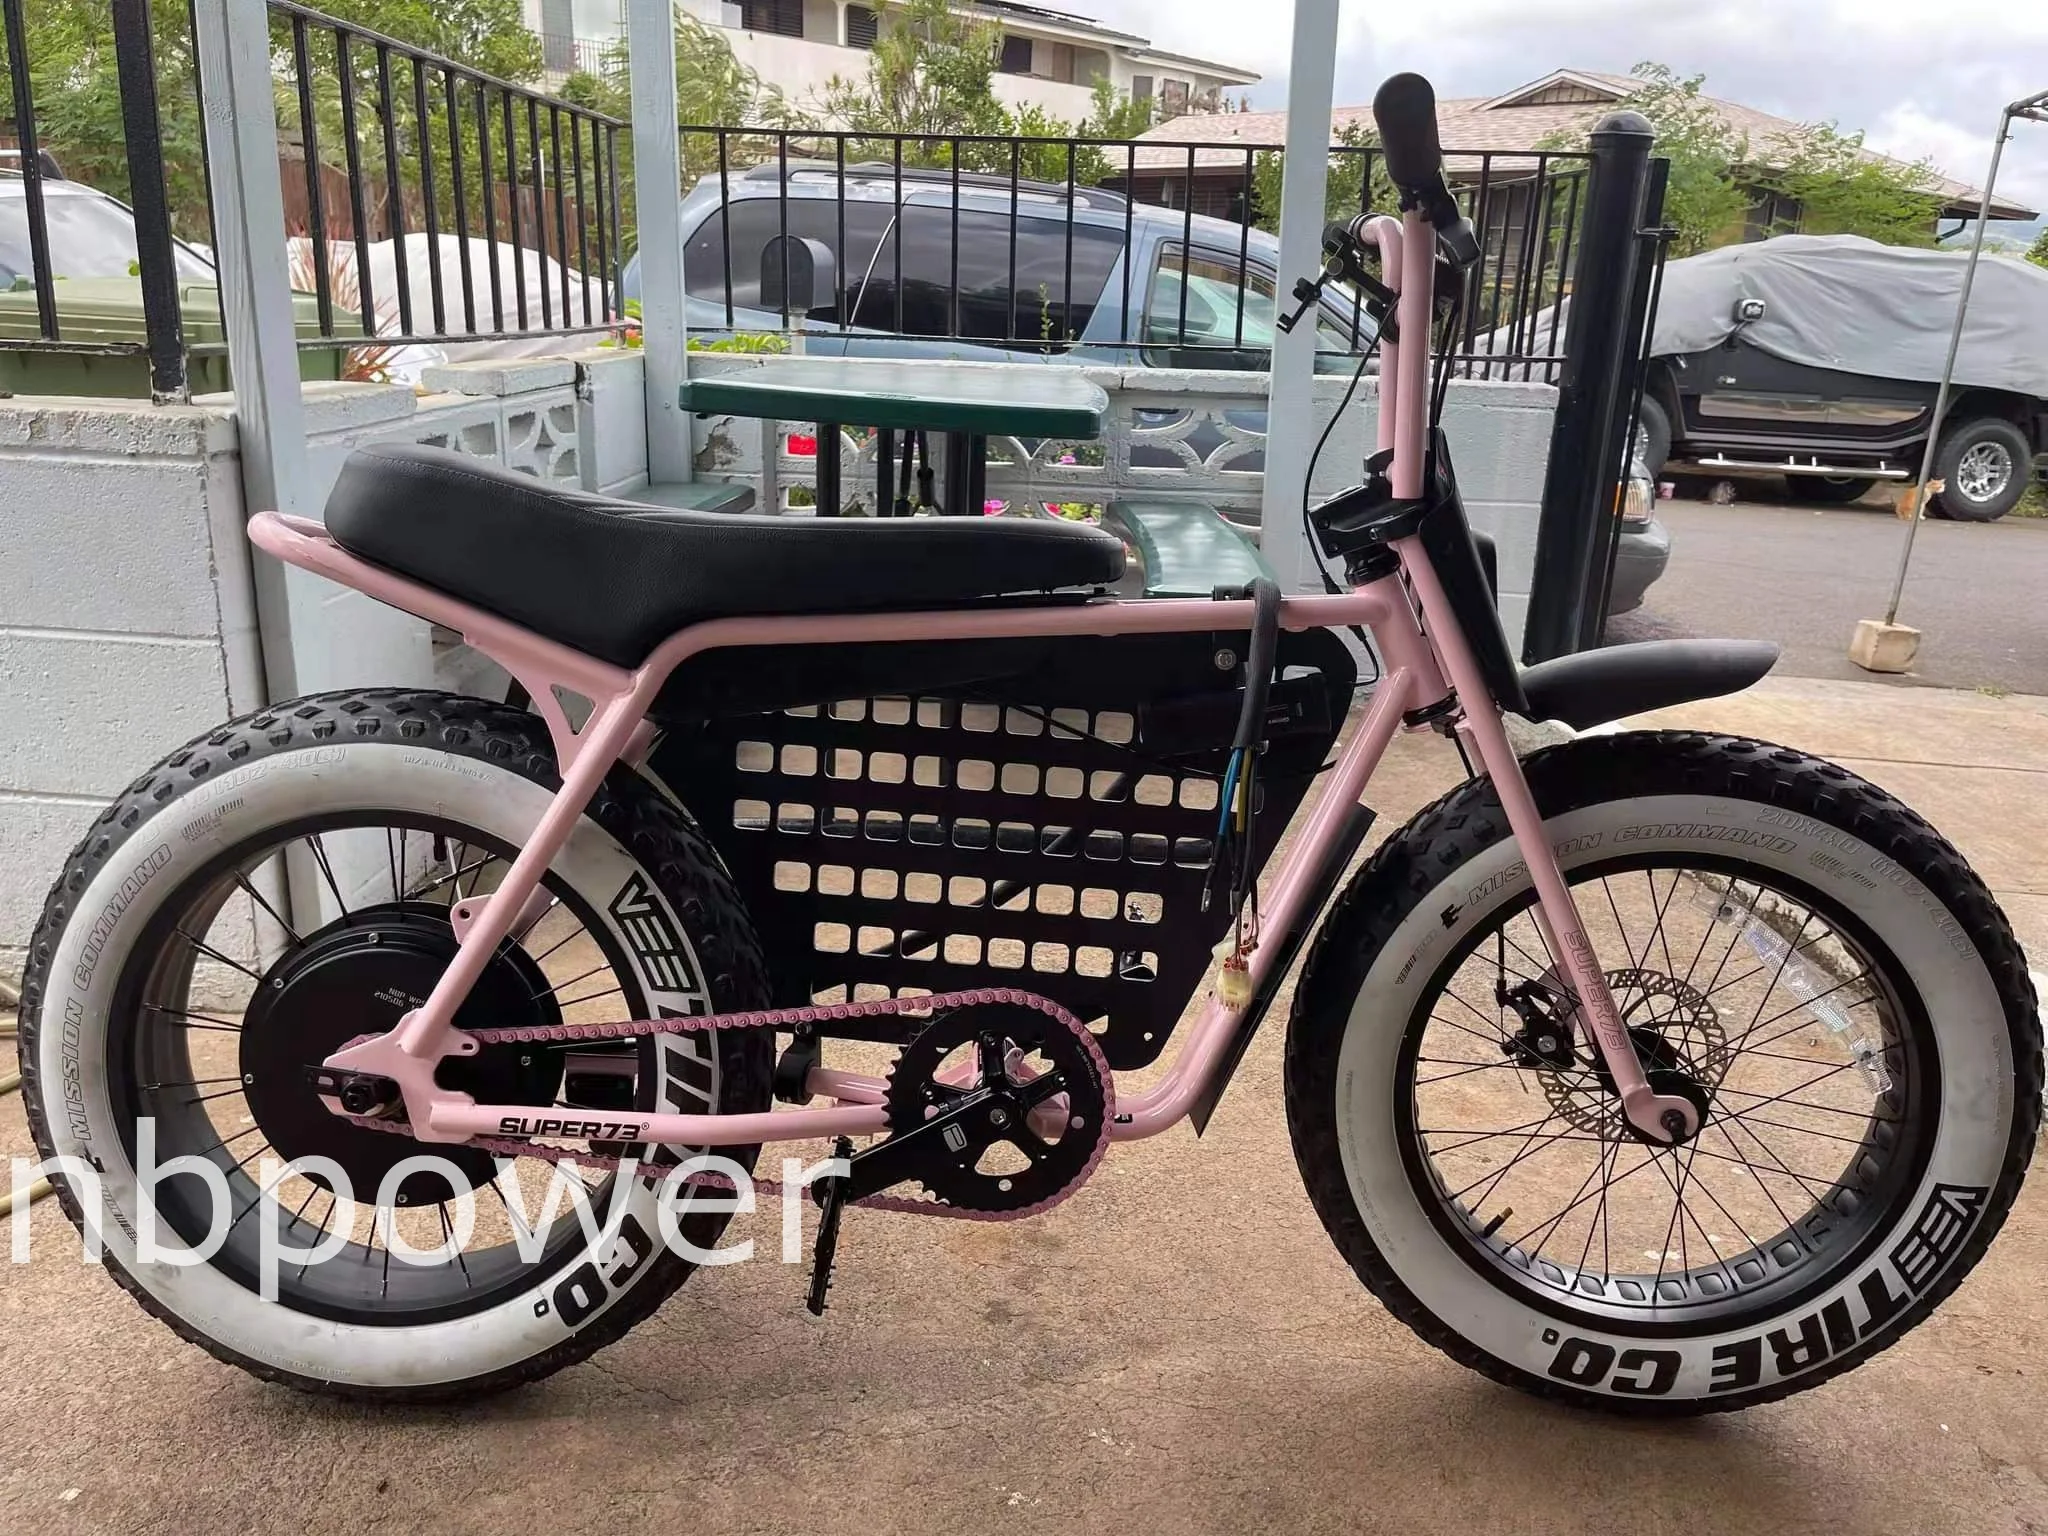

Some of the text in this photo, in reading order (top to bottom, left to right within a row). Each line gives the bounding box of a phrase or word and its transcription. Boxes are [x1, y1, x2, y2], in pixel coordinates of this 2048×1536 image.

[73, 843, 173, 992] COMMAND
[607, 870, 702, 994] VEE
[1440, 823, 1799, 930] E-MISON COMMAND
[1563, 929, 1628, 1051] SUPER73
[642, 999, 714, 1201] TI
[1889, 1183, 1990, 1296] VEE
[1708, 1267, 1916, 1393] TIRE
